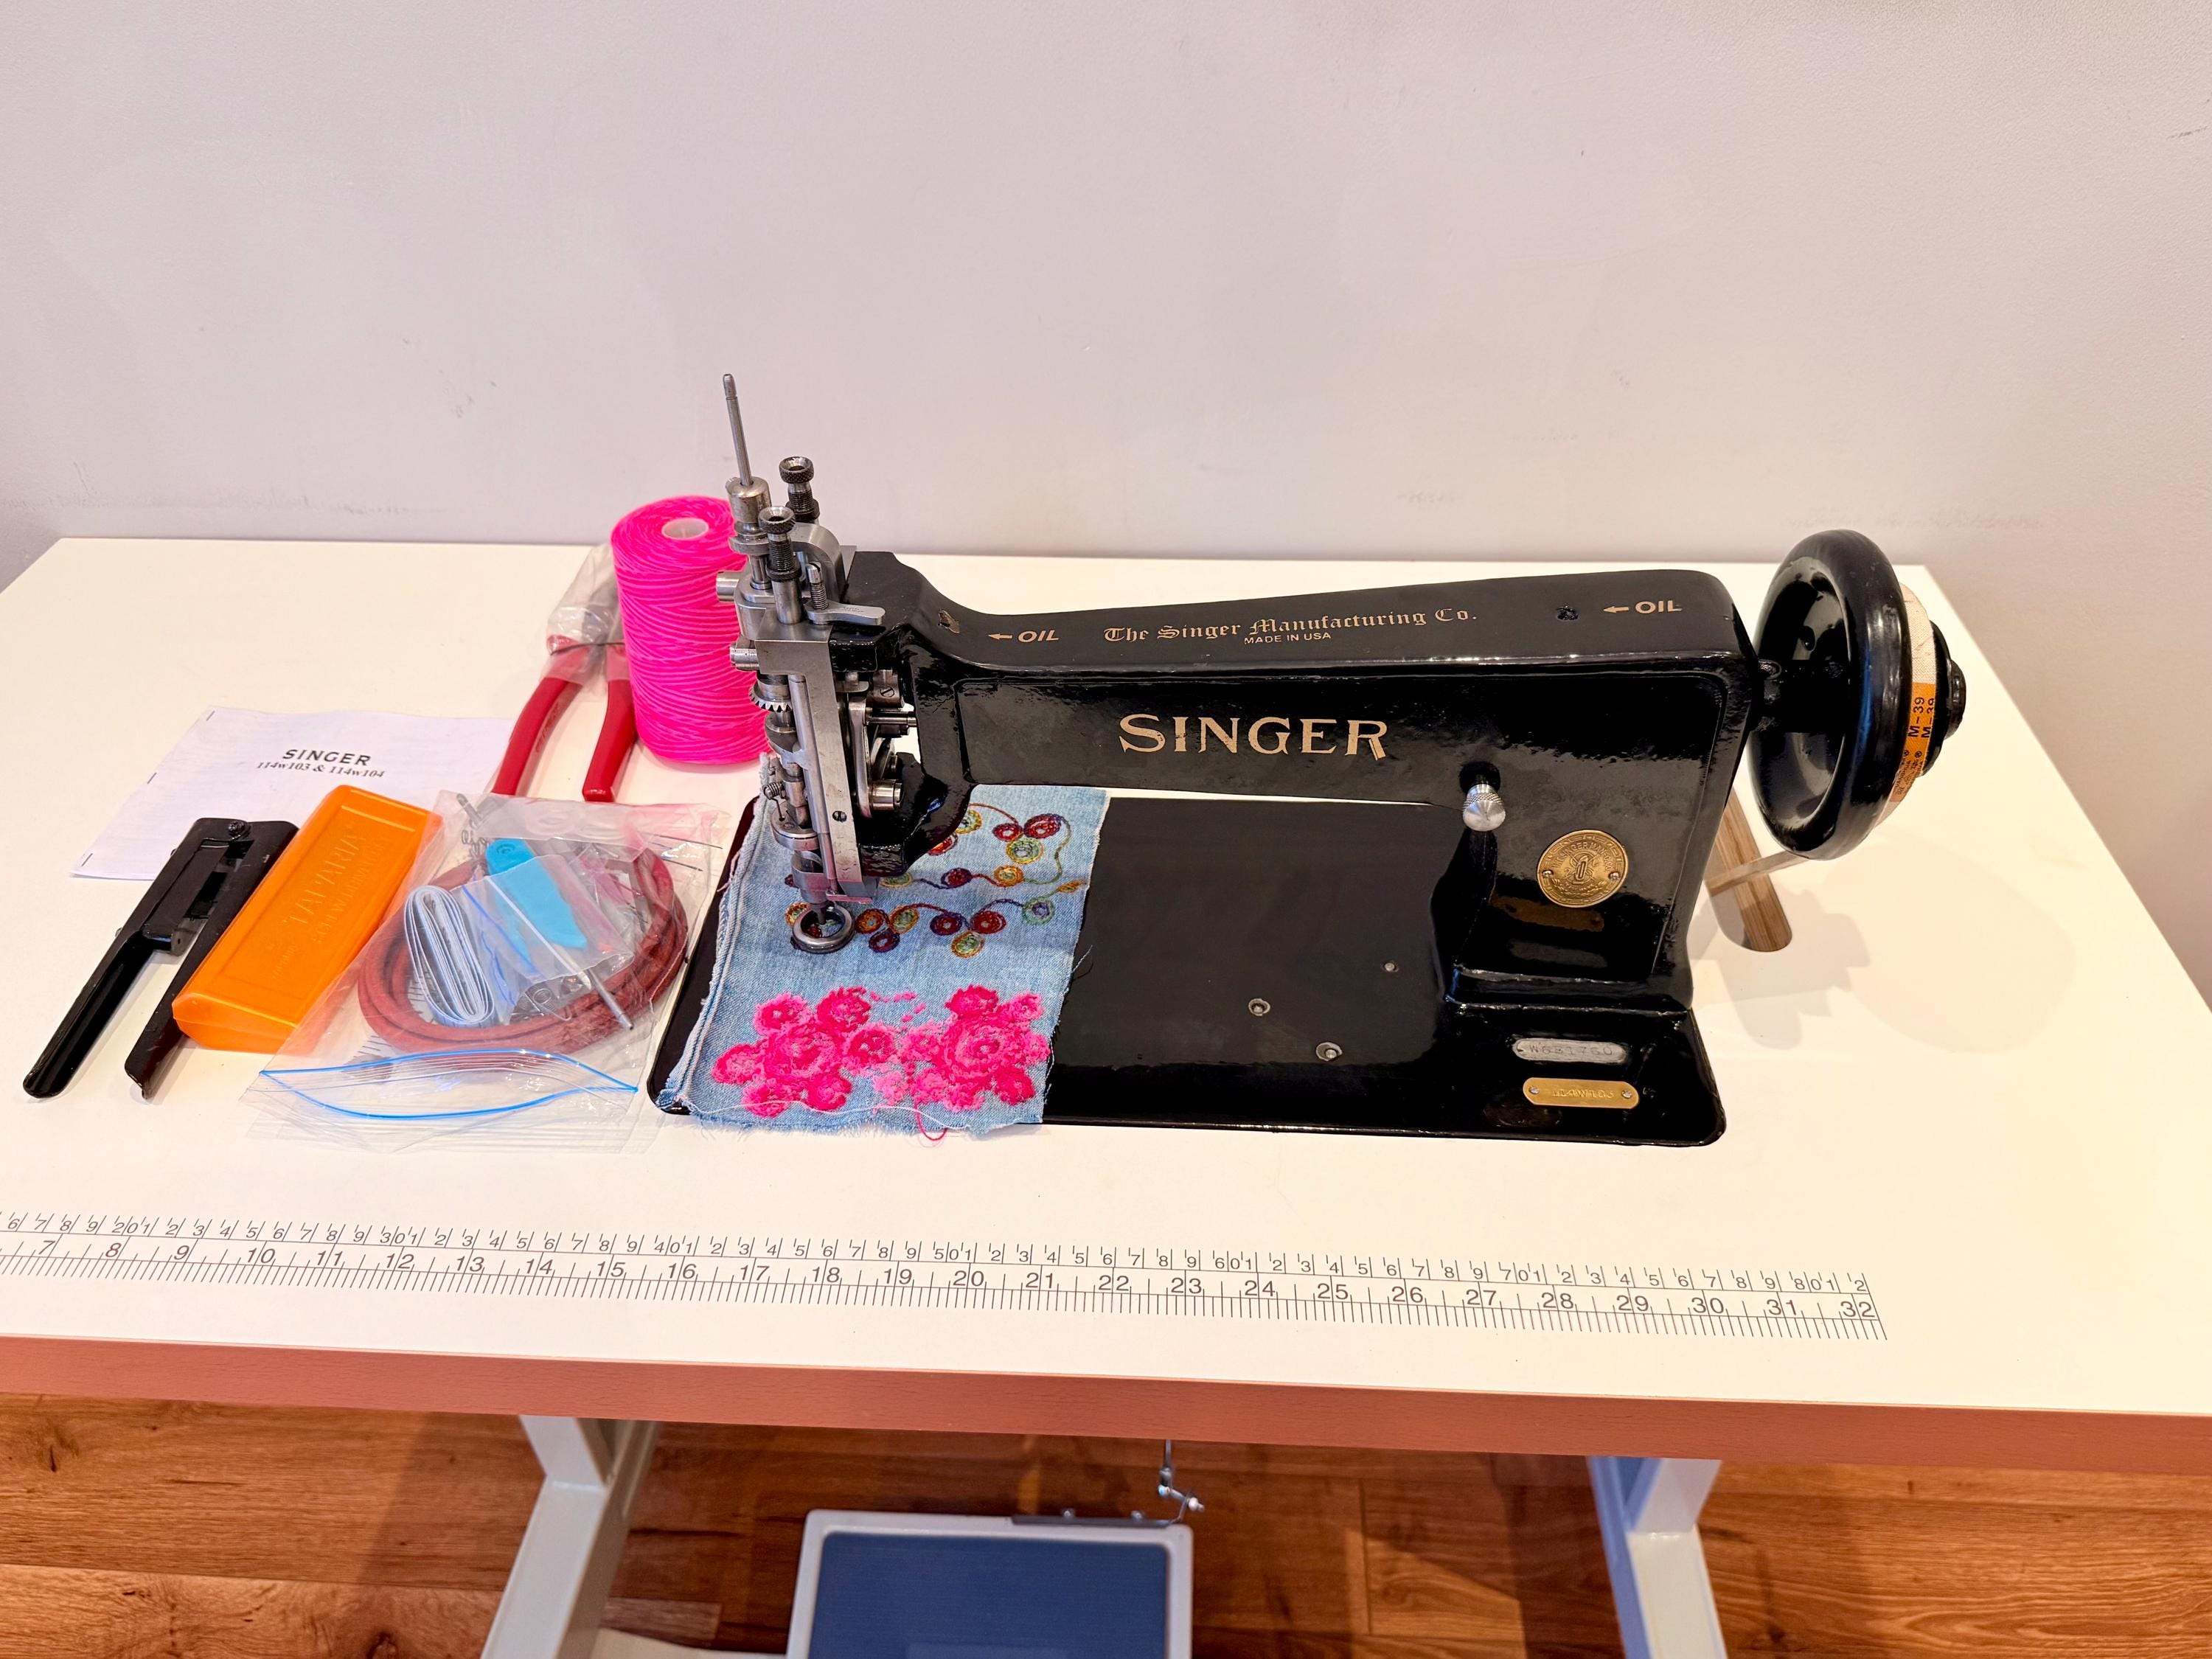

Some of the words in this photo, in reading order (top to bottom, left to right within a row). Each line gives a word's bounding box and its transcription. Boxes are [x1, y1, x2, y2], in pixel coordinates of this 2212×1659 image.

[1635, 600, 1683, 614] OIL
[1104, 627, 1149, 643] The
[1157, 625, 1241, 640] Singer
[1250, 611, 1427, 636] Manufacturing
[1435, 608, 1478, 622] Co.
[1018, 630, 1060, 643] OIL
[1245, 635, 1282, 644] MADE
[1287, 633, 1300, 641] IN
[1304, 632, 1332, 641] USA
[1118, 713, 1388, 761] SINGER
[282, 749, 371, 766] SINGER
[257, 762, 310, 771] 114w103
[329, 766, 385, 777] 114w104
[7, 1218, 20, 1229] 6
[34, 1219, 47, 1231] 7
[59, 1220, 72, 1231] 8
[86, 1221, 99, 1233] 9
[165, 1224, 178, 1235] 2
[192, 1225, 205, 1237] 3
[220, 1225, 232, 1237] 4
[246, 1227, 259, 1239] 5
[273, 1228, 285, 1239] 6
[300, 1229, 312, 1240] 7
[325, 1230, 338, 1242] 8
[352, 1231, 365, 1242] 9
[434, 1234, 447, 1246] 2
[462, 1235, 473, 1247] 3
[489, 1237, 501, 1248] 4
[516, 1237, 528, 1249] 5
[544, 1238, 555, 1250] 6
[571, 1239, 583, 1251] 7
[599, 1239, 610, 1252] 8
[627, 1240, 638, 1253] 9
[710, 1243, 723, 1255] 2
[739, 1244, 750, 1256] 3
[766, 1244, 777, 1256] 4
[795, 1245, 805, 1256] 5
[822, 1245, 833, 1257] 6
[851, 1246, 861, 1258] 7
[878, 1247, 888, 1259] 8
[906, 1248, 917, 1259] 9
[990, 1250, 1001, 1262] 2
[1018, 1251, 1029, 1262] 3
[1046, 1251, 1057, 1263] 4
[1074, 1252, 1085, 1264] 5
[1102, 1253, 1113, 1265] 6
[1130, 1254, 1141, 1266] 7
[1159, 1255, 1169, 1267] 8
[1186, 1256, 1197, 1268] 9
[1272, 1259, 1283, 1271] 2
[1301, 1260, 1311, 1273] 3
[1329, 1262, 1340, 1273] 4
[1357, 1263, 1368, 1275] 5
[1386, 1265, 1397, 1276] 6
[1415, 1265, 1425, 1277] 7
[1444, 1266, 1455, 1279] 8
[1472, 1267, 1484, 1279] 9
[1561, 1271, 1573, 1283] 2
[1590, 1272, 1601, 1284] 3
[1619, 1273, 1631, 1285] 4
[1649, 1274, 1659, 1286] 5
[1677, 1275, 1689, 1287] 6
[1705, 1276, 1717, 1287] 7
[1736, 1276, 1747, 1289] 8
[1764, 1277, 1776, 1290] 9
[1854, 1280, 1867, 1291] 2
[38, 1240, 55, 1255] 7
[105, 1242, 122, 1258] 8
[173, 1245, 190, 1260] 9
[247, 1248, 276, 1264] 10
[317, 1251, 343, 1267] 11
[386, 1253, 414, 1270] 12
[456, 1256, 484, 1273] 13
[526, 1259, 554, 1275] 14
[597, 1261, 626, 1277] 15
[668, 1262, 697, 1279] 16
[740, 1265, 770, 1281] 17
[812, 1267, 841, 1283] 18
[883, 1268, 913, 1284] 19
[953, 1270, 985, 1287] 20
[1025, 1272, 1054, 1289] 21
[1098, 1275, 1130, 1291] 22
[1171, 1277, 1202, 1294] 23
[1244, 1279, 1276, 1297] 24
[1317, 1283, 1349, 1300] 25
[1391, 1286, 1423, 1303] 26
[1466, 1289, 1497, 1306] 27
[1541, 1292, 1574, 1310] 28
[1616, 1294, 1649, 1312] 29
[1691, 1297, 1724, 1314] 30
[1766, 1299, 1797, 1316] 31
[1840, 1301, 1875, 1318] 32
